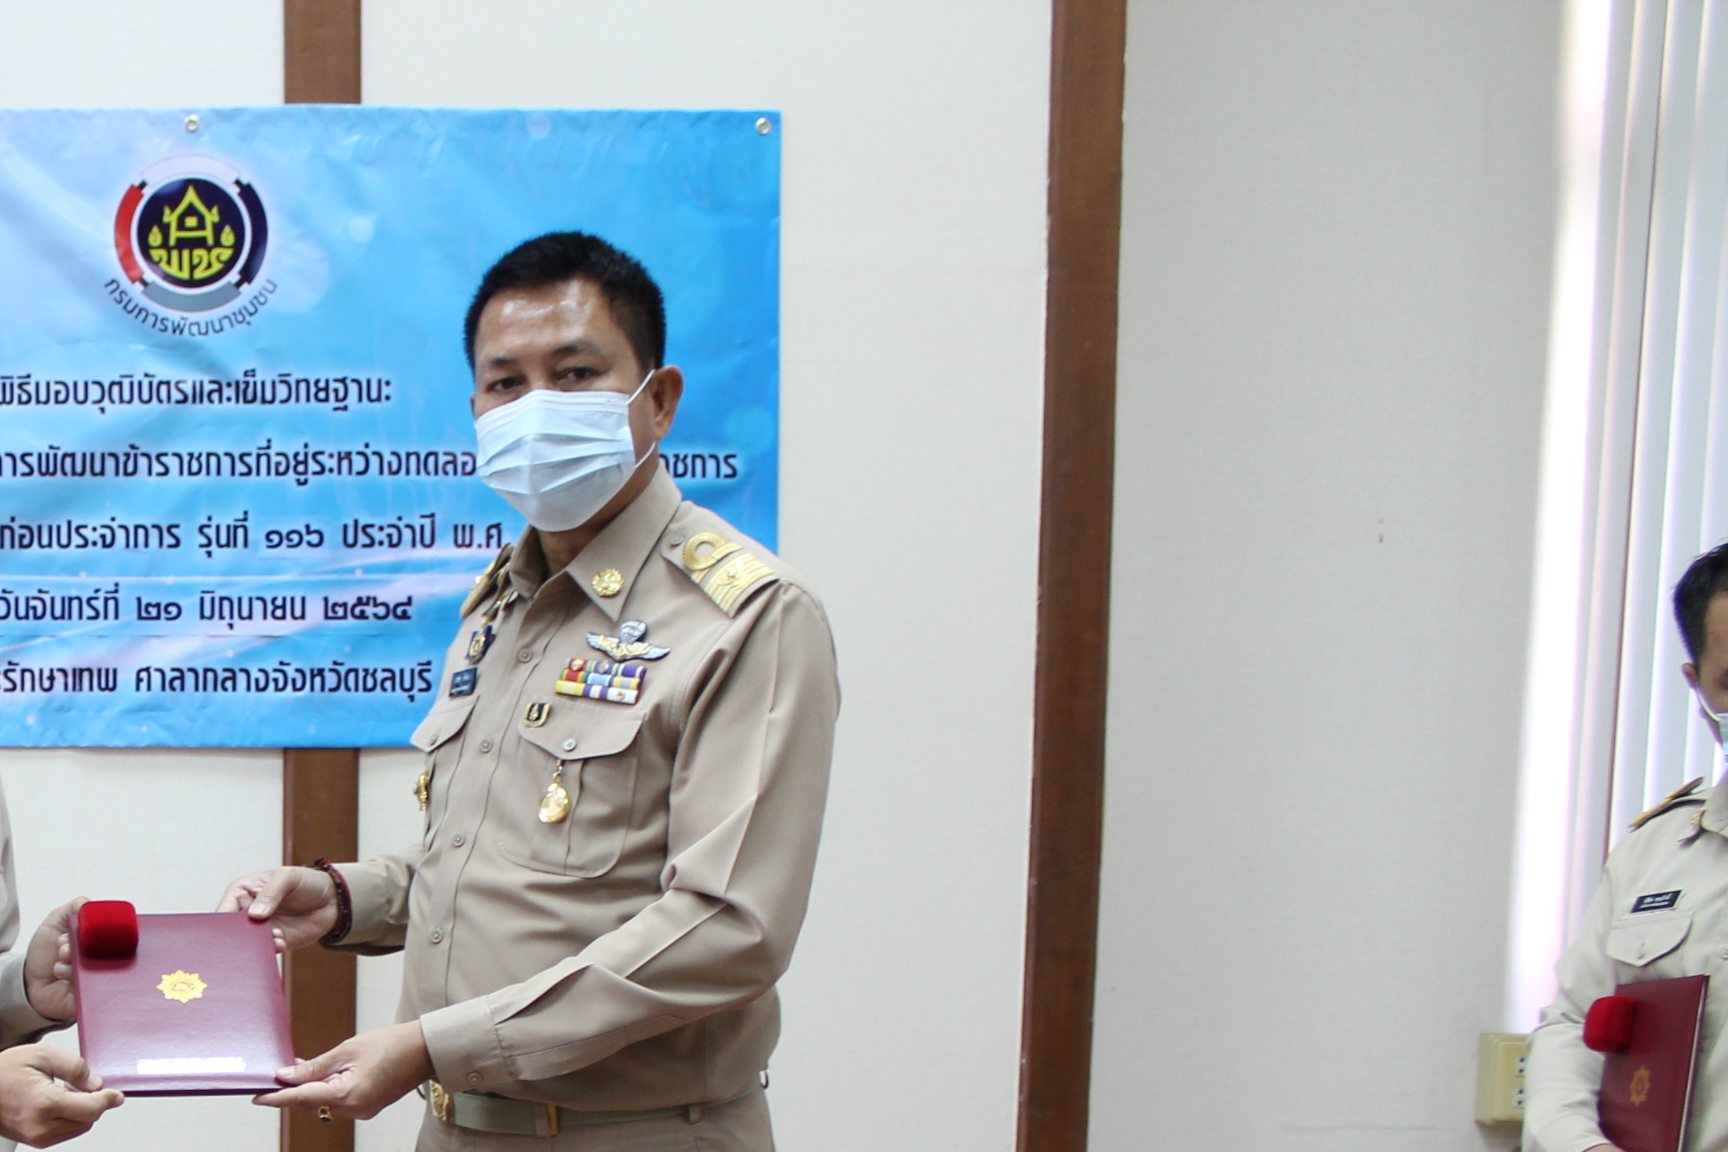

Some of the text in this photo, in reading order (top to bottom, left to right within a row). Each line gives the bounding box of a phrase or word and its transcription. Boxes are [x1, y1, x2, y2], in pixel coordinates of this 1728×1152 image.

[104, 278, 279, 337] กรมการพัฒนาชุมชน
[198, 511, 249, 558] รุ่นที่
[264, 523, 324, 549] ๑๑๖
[343, 513, 436, 549] ประจำปี
[136, 597, 183, 621] ๒๑
[200, 591, 306, 630] มิถุนายน
[323, 595, 413, 621] ๒๕๖๔
[135, 660, 433, 703] ศาลากลางจังหวัดชลบุรี
